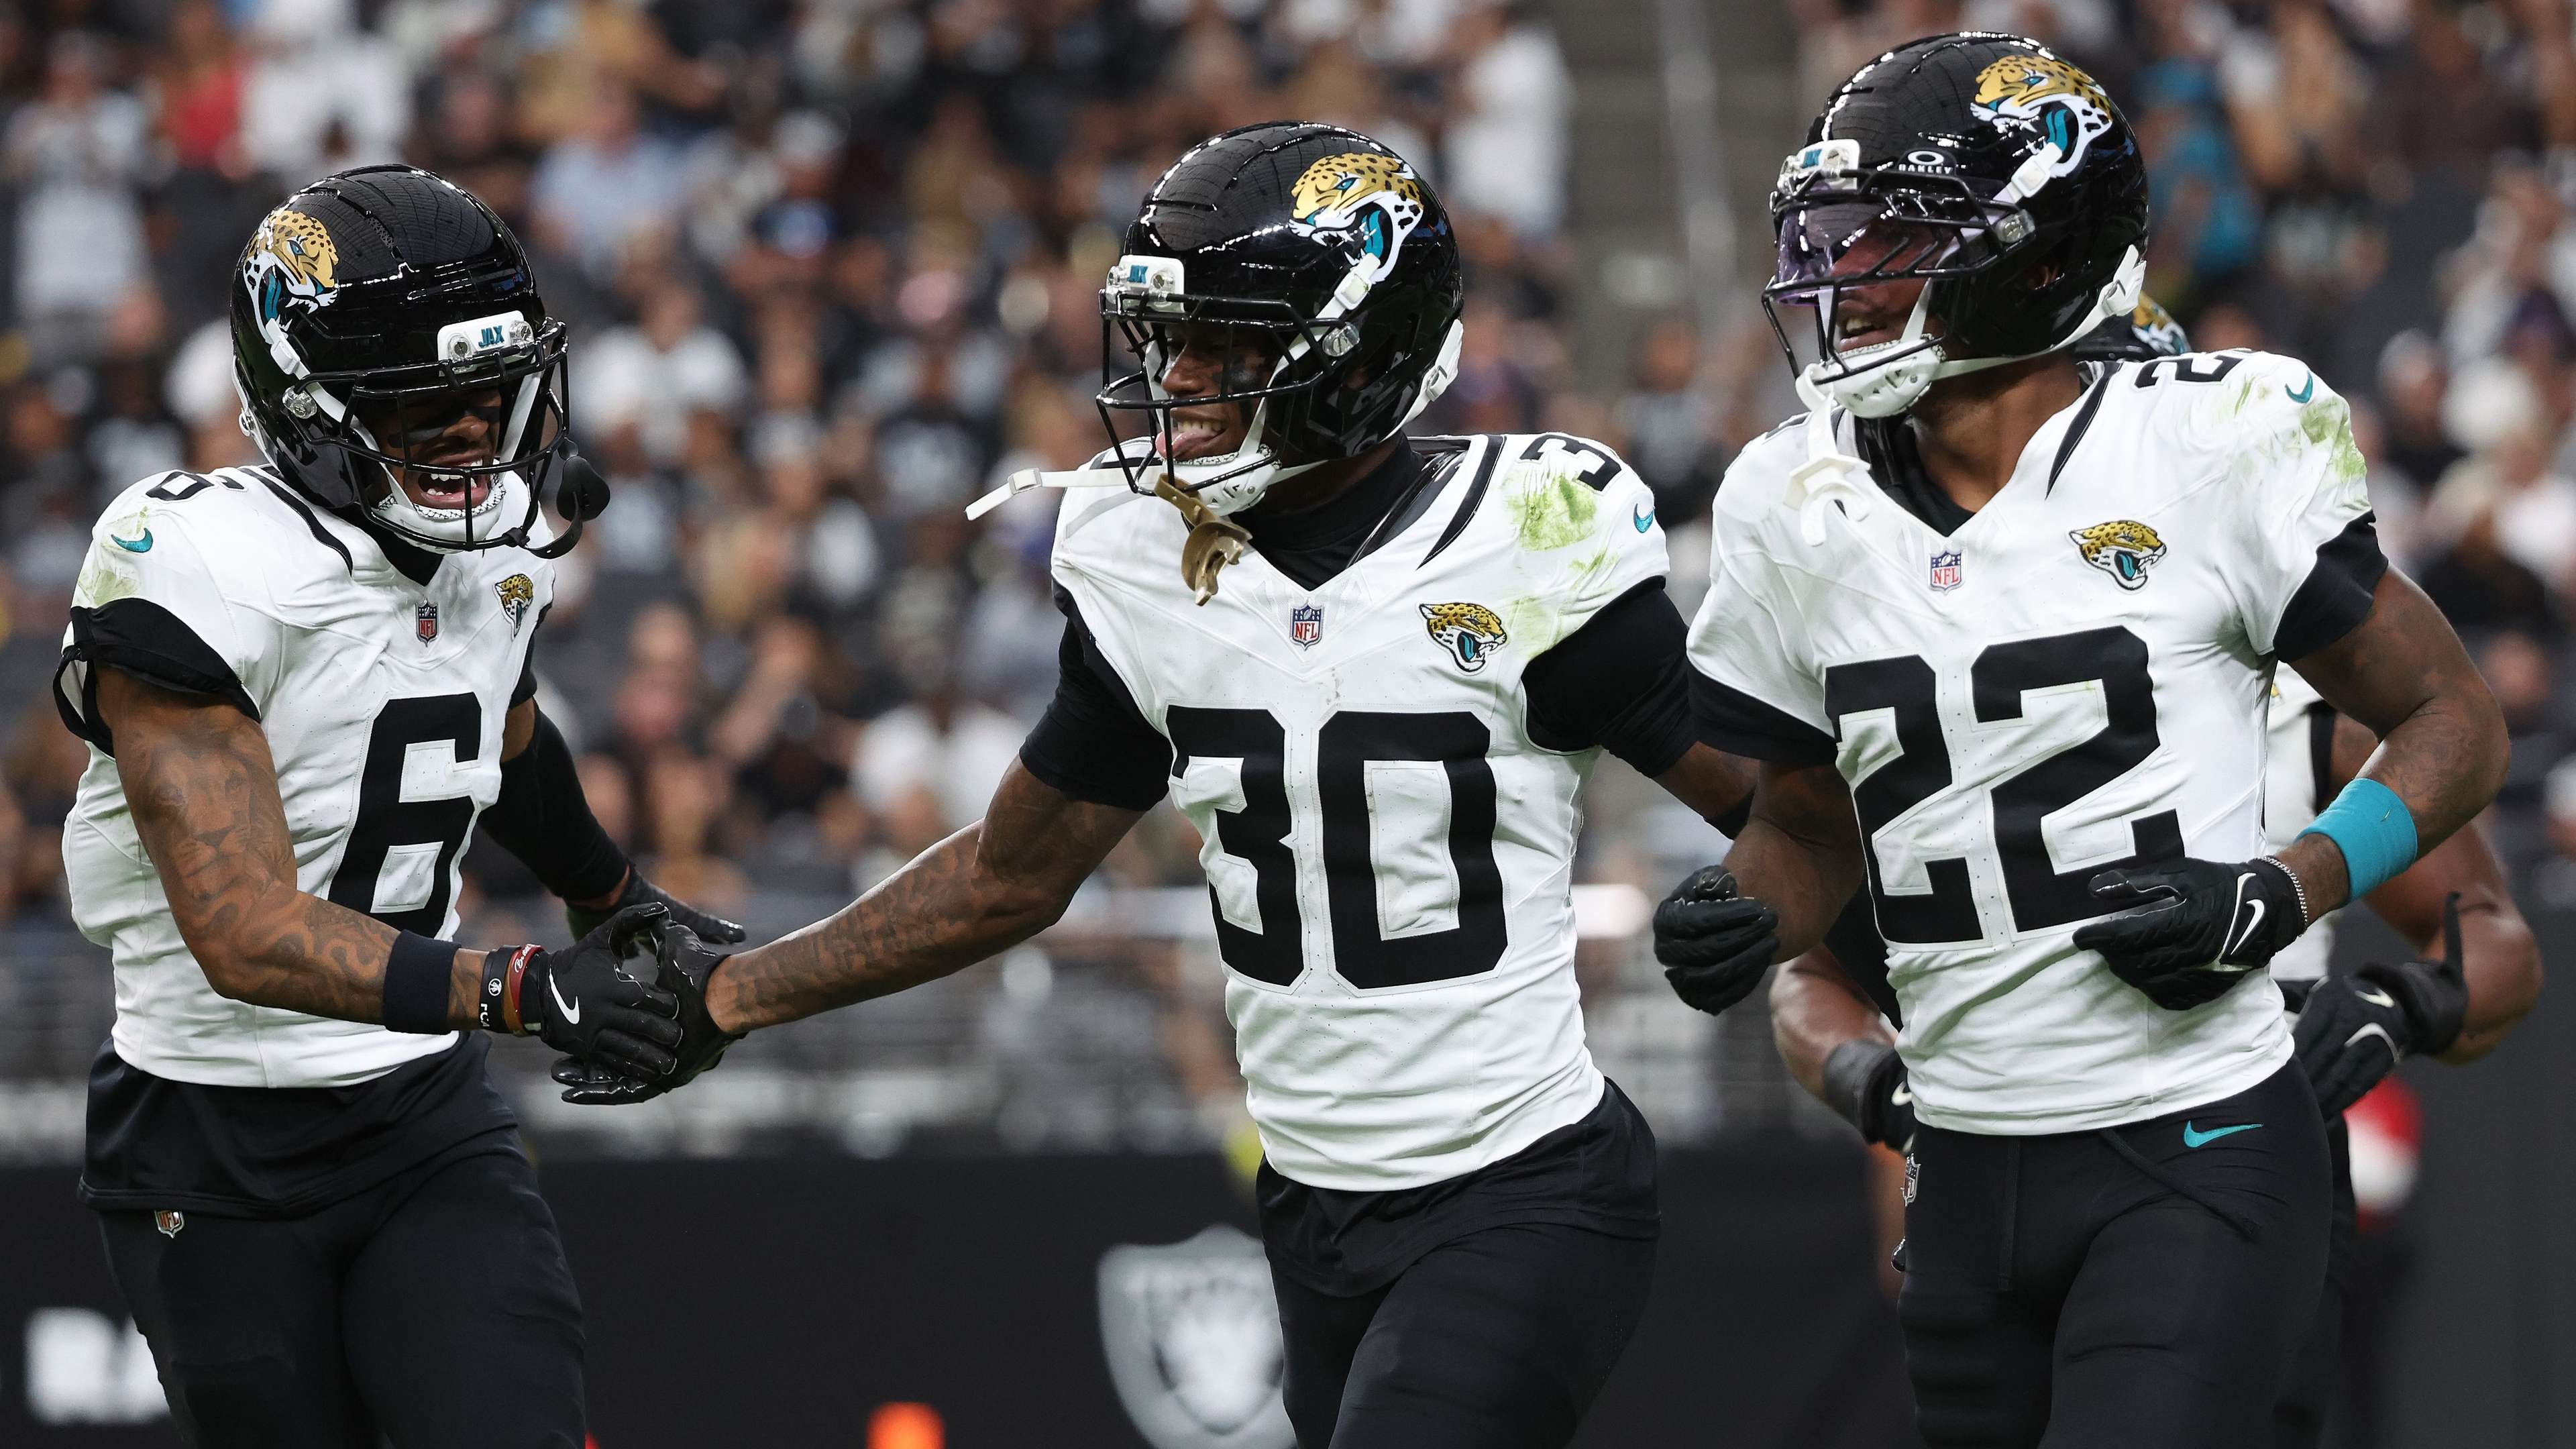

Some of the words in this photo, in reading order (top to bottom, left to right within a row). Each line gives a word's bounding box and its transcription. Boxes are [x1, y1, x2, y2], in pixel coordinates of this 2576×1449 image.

[1898, 164, 1953, 174] OAKLEY
[478, 325, 504, 347] JAX
[1933, 568, 1958, 586] NFL
[419, 620, 435, 638] NFL
[1295, 623, 1317, 641] NFL
[1825, 625, 2186, 944] 22
[327, 692, 482, 939] 6
[1166, 704, 1508, 989] 30
